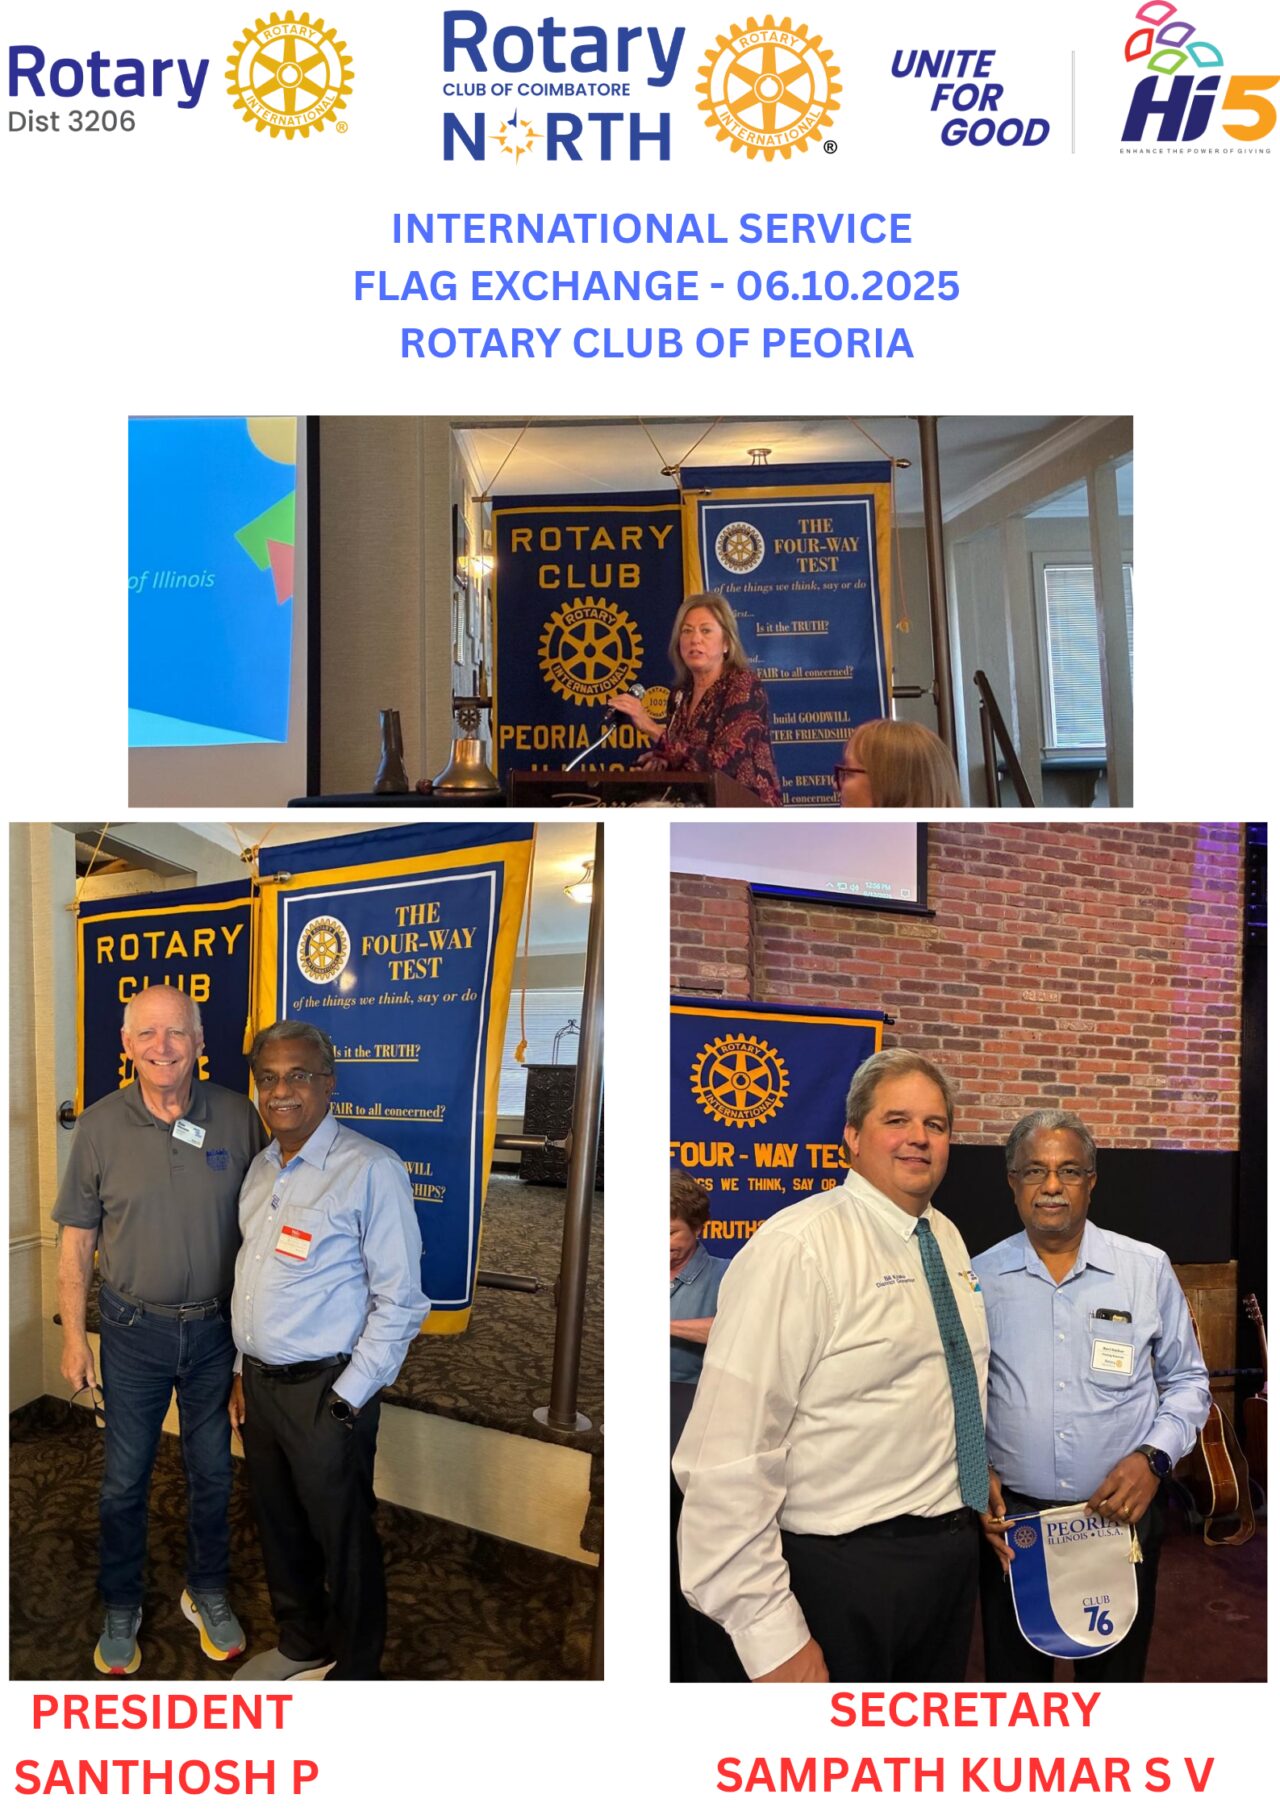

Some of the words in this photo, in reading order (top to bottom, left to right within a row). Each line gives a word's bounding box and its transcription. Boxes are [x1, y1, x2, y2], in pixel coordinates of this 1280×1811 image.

[798, 518, 834, 534] THE
[511, 525, 674, 552] ROTARY
[773, 537, 860, 554] FOUR-WAY
[796, 556, 839, 573] TEST
[152, 570, 216, 589] Illinois
[539, 563, 641, 589] CLUB
[726, 580, 743, 593] the
[743, 582, 774, 595] things
[776, 583, 789, 592] we
[822, 582, 839, 593] say
[841, 583, 852, 592] or
[854, 579, 867, 589] do
[565, 608, 617, 625] ROTARY
[756, 622, 765, 634] Is
[766, 622, 774, 633] it
[775, 621, 791, 632] the
[792, 620, 829, 632] TRUTH?
[552, 663, 628, 694] INTERNATIONAL
[780, 669, 790, 678] to
[791, 667, 804, 678] all
[804, 665, 854, 678] concerned?
[773, 713, 797, 725] build
[798, 711, 851, 724] GOODWILL
[501, 723, 591, 750] PEORIA
[782, 776, 793, 787] be
[395, 901, 441, 928] THE
[97, 924, 245, 965] ROTARY
[361, 927, 478, 957] FOUR-WAY
[388, 957, 444, 981] TEST
[293, 997, 306, 1012] of
[305, 997, 321, 1009] the
[322, 994, 357, 1010] things
[358, 996, 376, 1006] we
[378, 991, 415, 1006] think,
[417, 993, 439, 1006] say
[442, 992, 458, 1002] or
[461, 987, 478, 1001] do
[344, 1046, 352, 1057] it
[354, 1044, 372, 1057] the
[373, 1043, 421, 1058] TRUTH?
[720, 1043, 762, 1055] ROTARY
[329, 1102, 353, 1115] FAIR
[355, 1104, 366, 1116] to
[368, 1103, 382, 1116] all
[384, 1104, 446, 1118] concerned?
[706, 1093, 776, 1119] INTERNATIONAL
[753, 1143, 799, 1168] WAY
[721, 1177, 740, 1191] WE
[748, 1177, 786, 1194] THINK,
[793, 1177, 814, 1191] SAY
[821, 1178, 837, 1190] OR
[1047, 1533, 1088, 1545] ILLINOIS
[1097, 1528, 1124, 1538] U.S.A.
[1082, 1594, 1111, 1607] CLUB
[1083, 1605, 1114, 1636] 76
